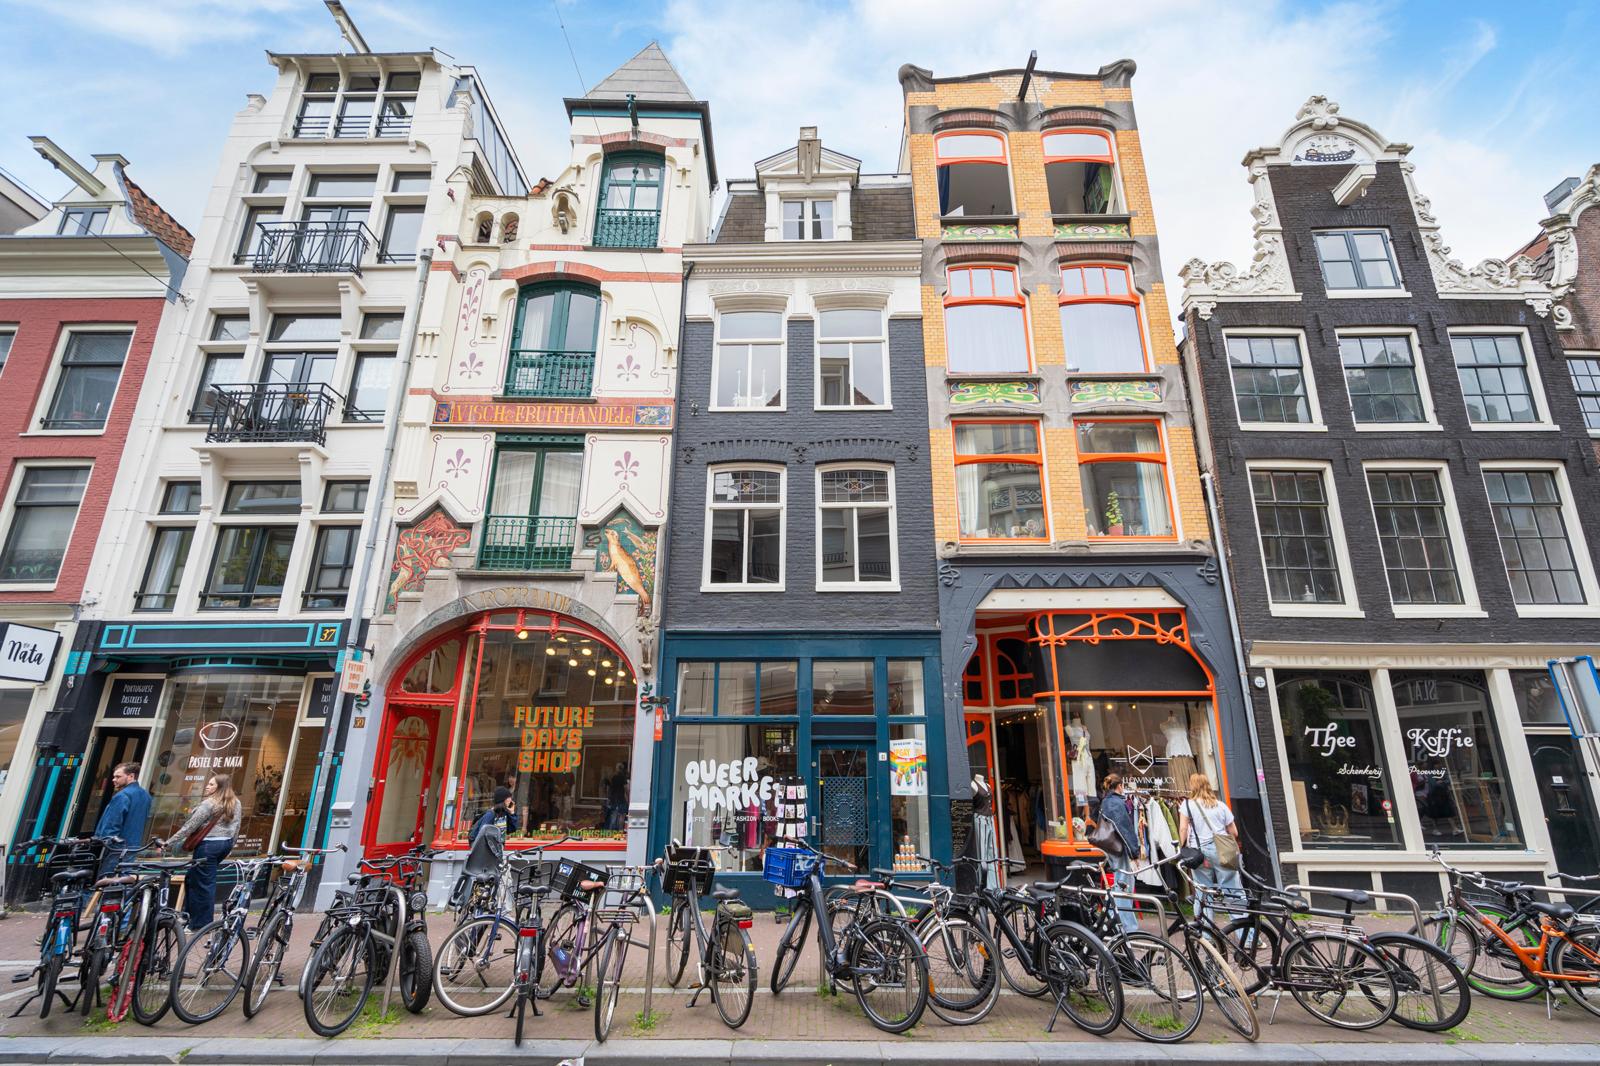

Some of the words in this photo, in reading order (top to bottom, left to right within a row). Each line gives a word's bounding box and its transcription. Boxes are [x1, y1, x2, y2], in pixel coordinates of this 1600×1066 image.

[456, 404, 505, 422] VISCH
[515, 405, 633, 424] FRUITHANDEL
[320, 628, 337, 641] 37
[7, 639, 45, 665] Nata
[347, 662, 365, 673] FUTURE
[123, 684, 154, 693] PORTUGUESE
[121, 695, 143, 704] PASTRIES
[143, 695, 149, 704] &
[122, 706, 142, 716] COFFEE
[513, 705, 595, 728] FUTURE
[521, 728, 582, 750] DAYS
[1304, 722, 1357, 757] Thee
[1406, 728, 1474, 757] Koffie
[188, 756, 211, 768] PASTEL
[212, 756, 223, 768] DE
[223, 756, 243, 768] NATA
[518, 751, 582, 773] SHOP
[685, 756, 759, 788] QUEER
